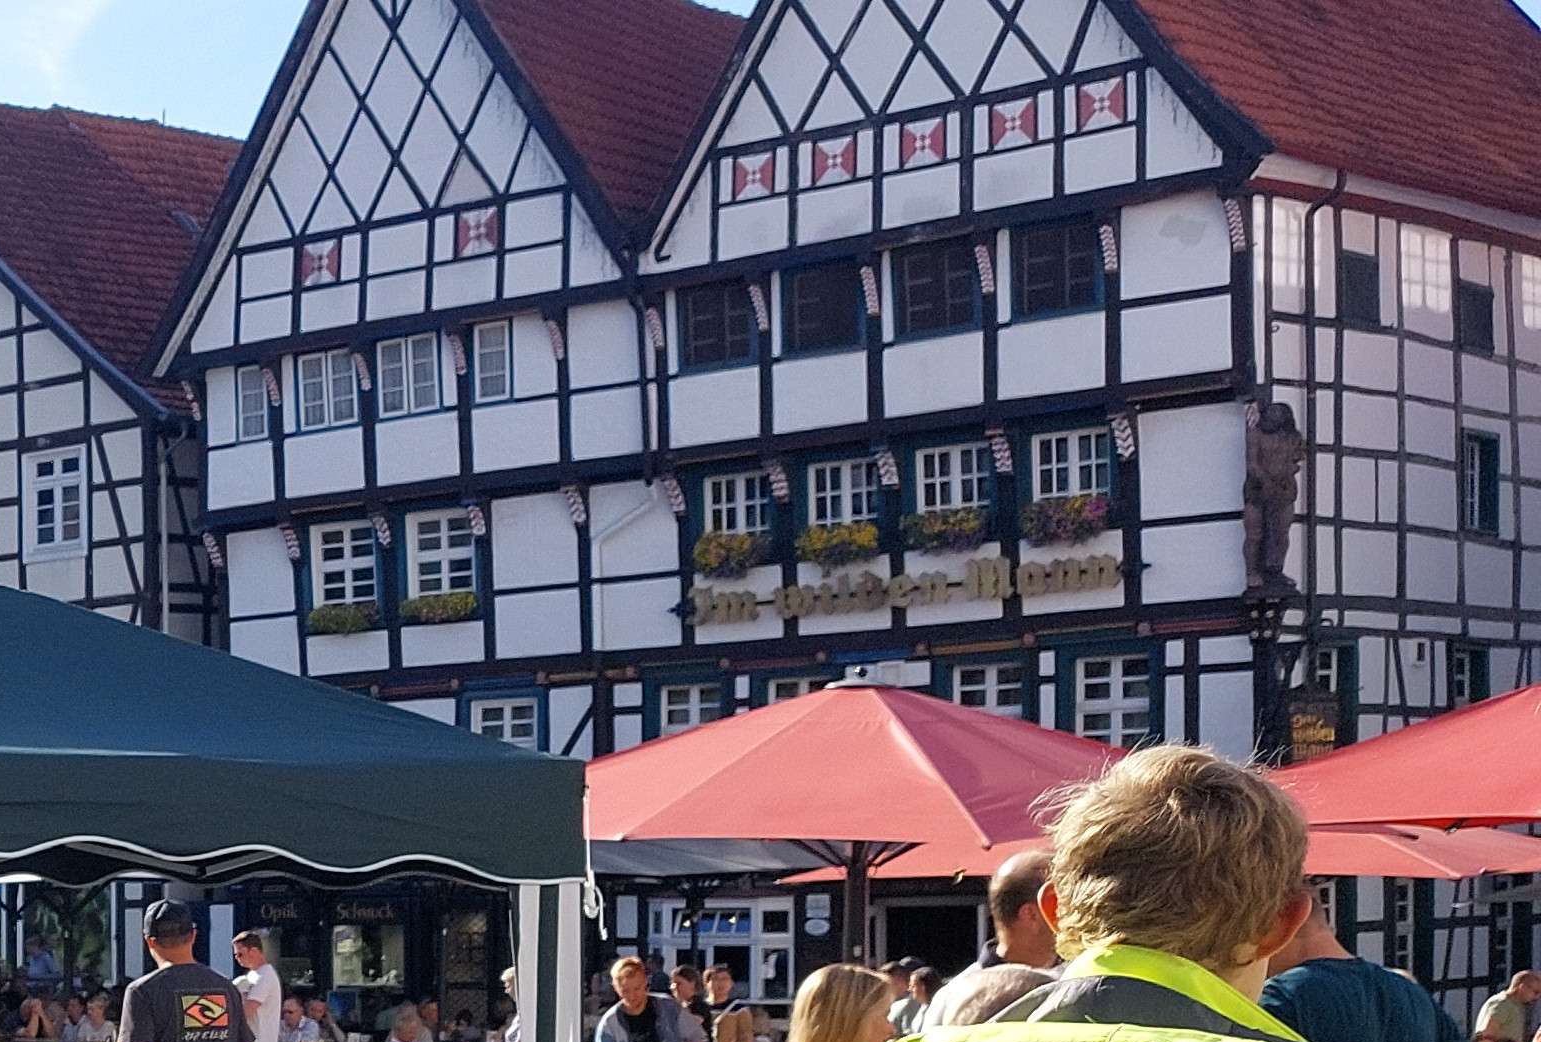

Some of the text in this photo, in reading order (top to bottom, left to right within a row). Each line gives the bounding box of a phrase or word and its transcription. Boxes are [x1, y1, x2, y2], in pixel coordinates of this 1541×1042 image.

[963, 553, 1124, 600] Mann
[260, 903, 299, 922] Optik
[336, 903, 395, 920] Schmuck
